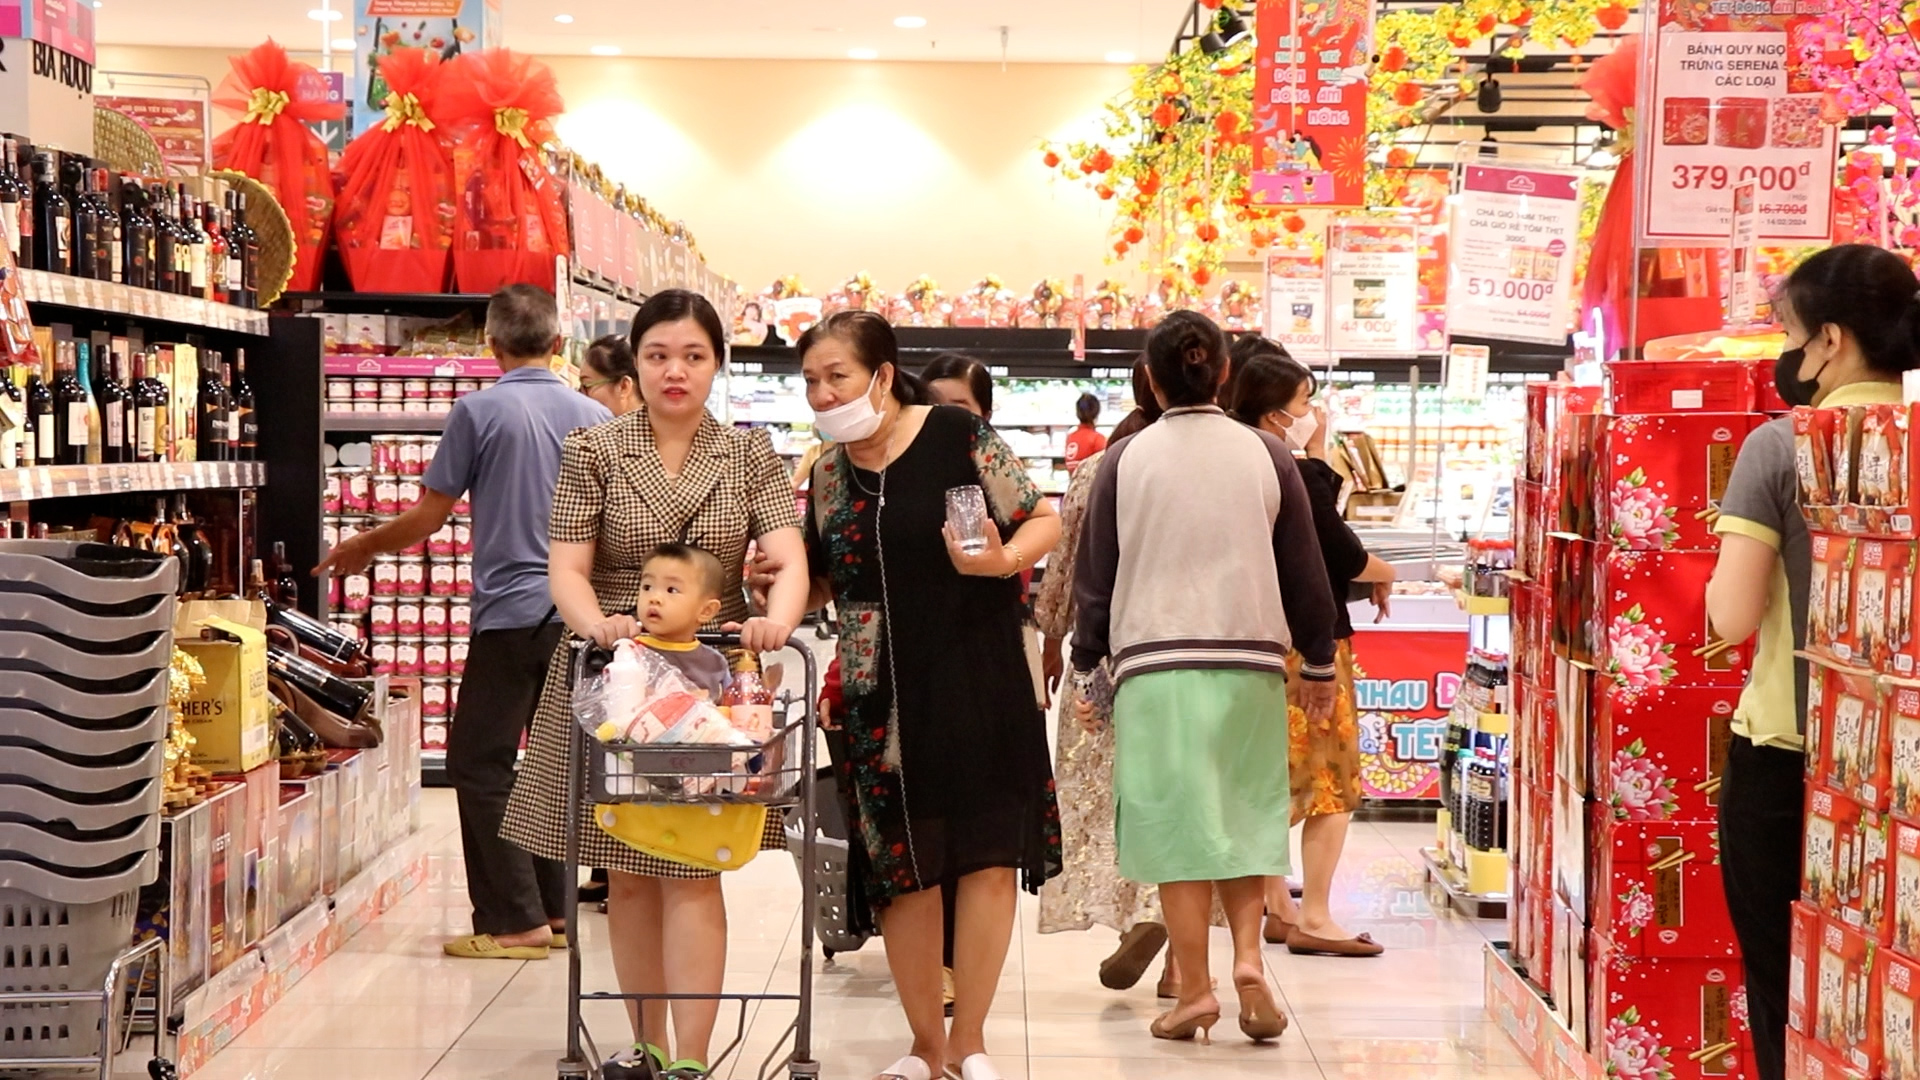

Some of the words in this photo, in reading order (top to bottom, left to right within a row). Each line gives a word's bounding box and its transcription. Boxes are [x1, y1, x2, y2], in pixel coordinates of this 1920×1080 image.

[1687, 42, 1722, 55] BÁNH
[1726, 45, 1751, 56] QUY
[33, 40, 56, 80] BIA
[1681, 58, 1724, 70] TRỨNG
[1727, 61, 1780, 70] SERENA
[1715, 73, 1743, 86] CÁC
[1746, 76, 1776, 89] LOẠI
[1354, 680, 1428, 709] NHAU
